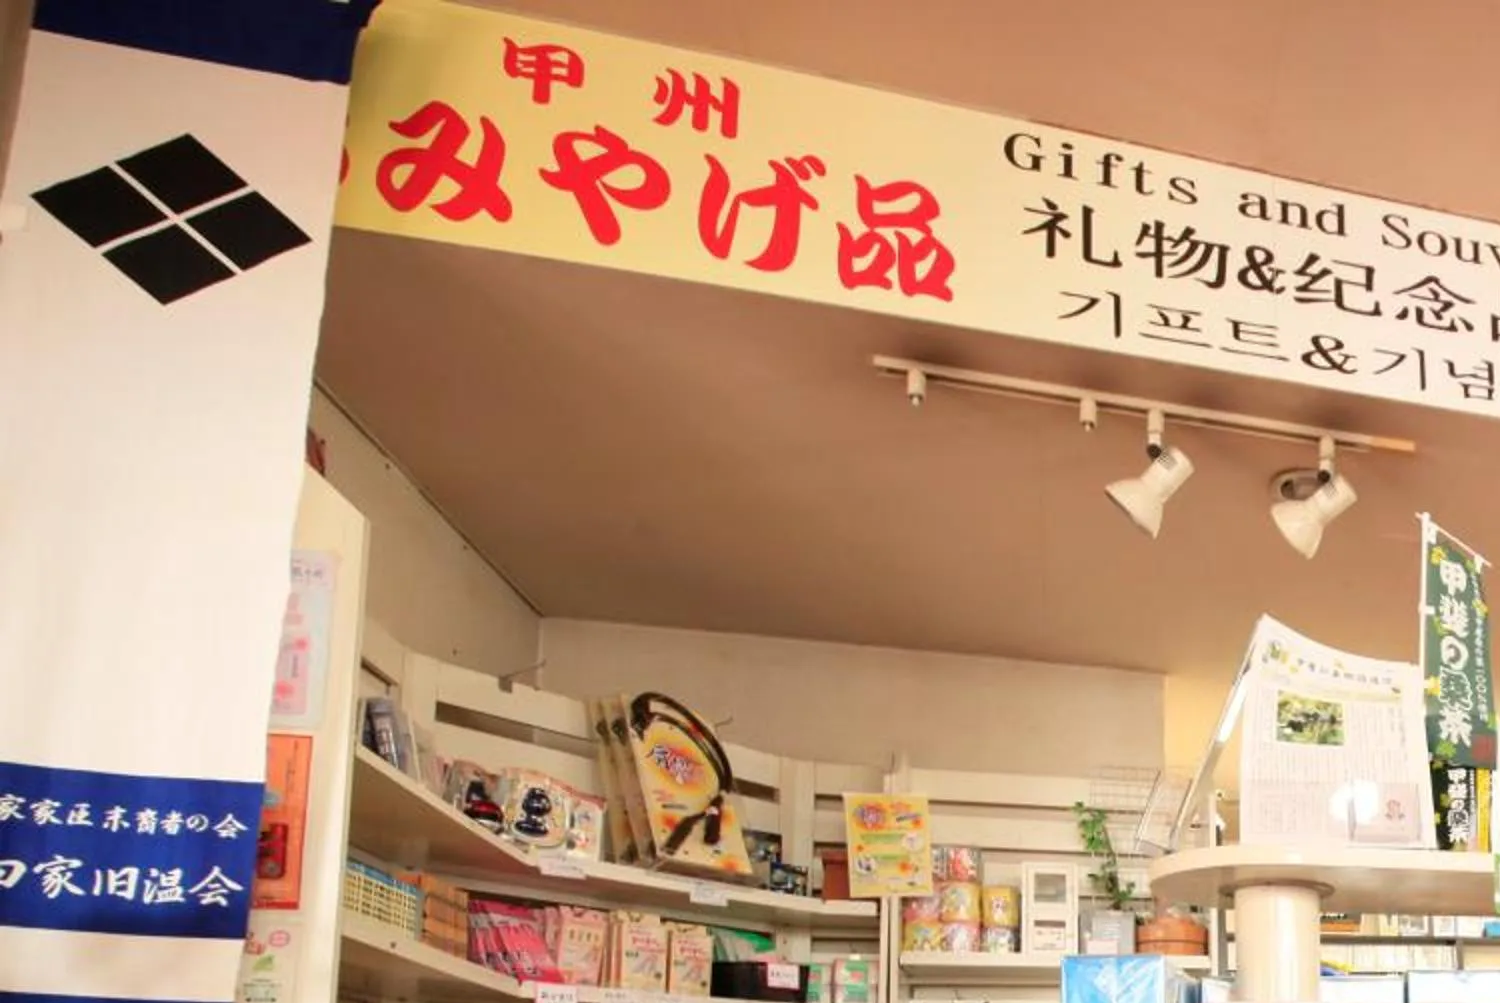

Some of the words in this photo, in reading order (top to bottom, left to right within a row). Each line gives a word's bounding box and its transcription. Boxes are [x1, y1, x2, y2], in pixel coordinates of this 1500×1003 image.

[338, 100, 955, 302] みやげ品
[1003, 132, 1198, 206] Gifts
[1238, 191, 1347, 238] and
